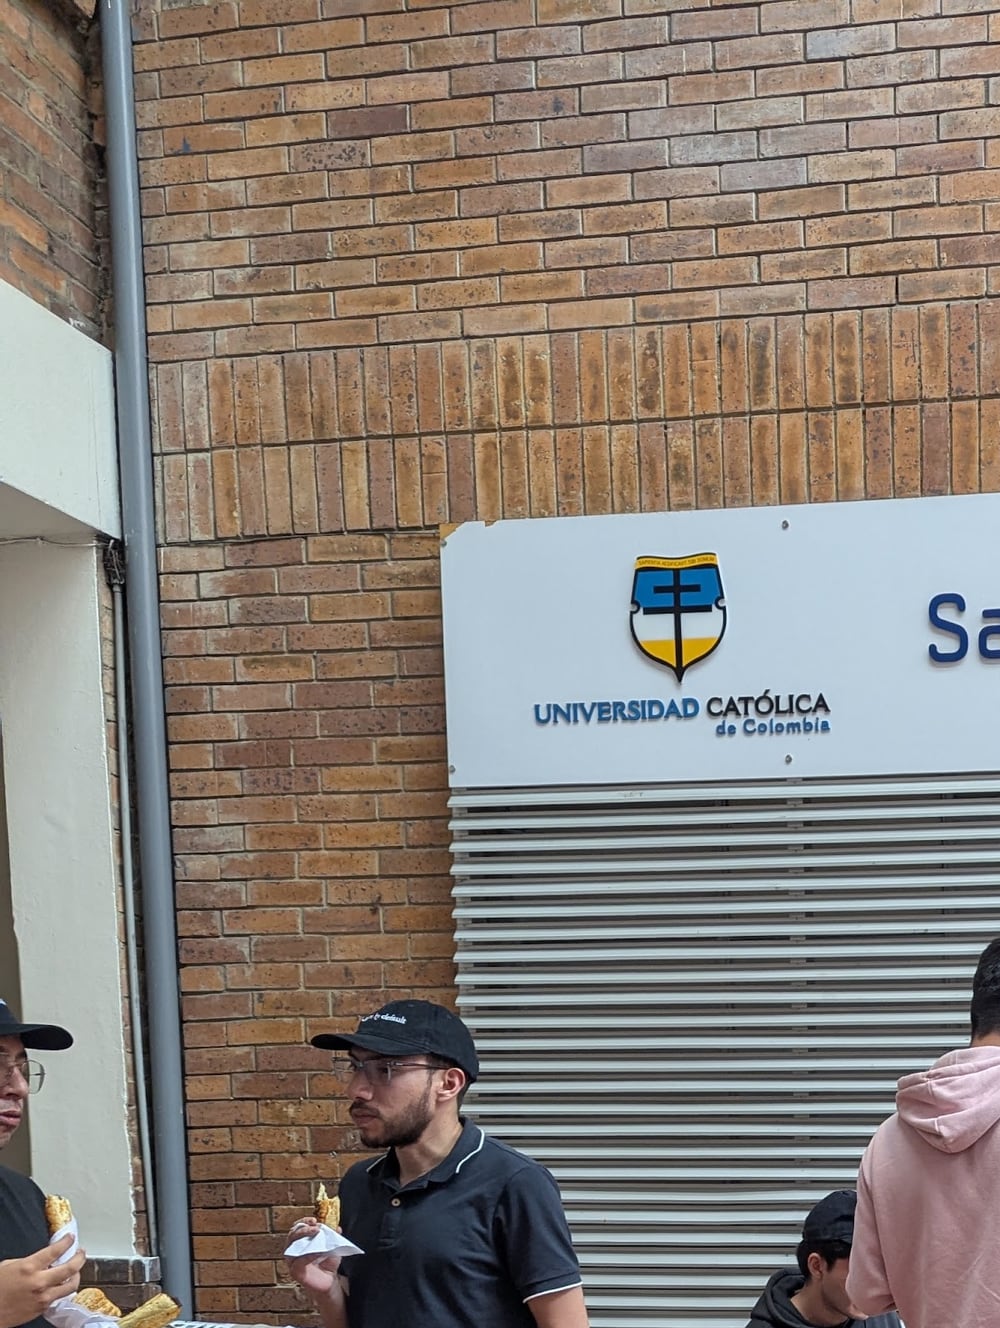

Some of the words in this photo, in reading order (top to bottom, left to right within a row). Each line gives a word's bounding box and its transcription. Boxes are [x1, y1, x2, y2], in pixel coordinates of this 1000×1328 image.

[534, 697, 700, 724] UNIVERSIDAD
[706, 689, 831, 716] CATÓLICA
[716, 720, 736, 735] de
[743, 717, 831, 735] Colombia
